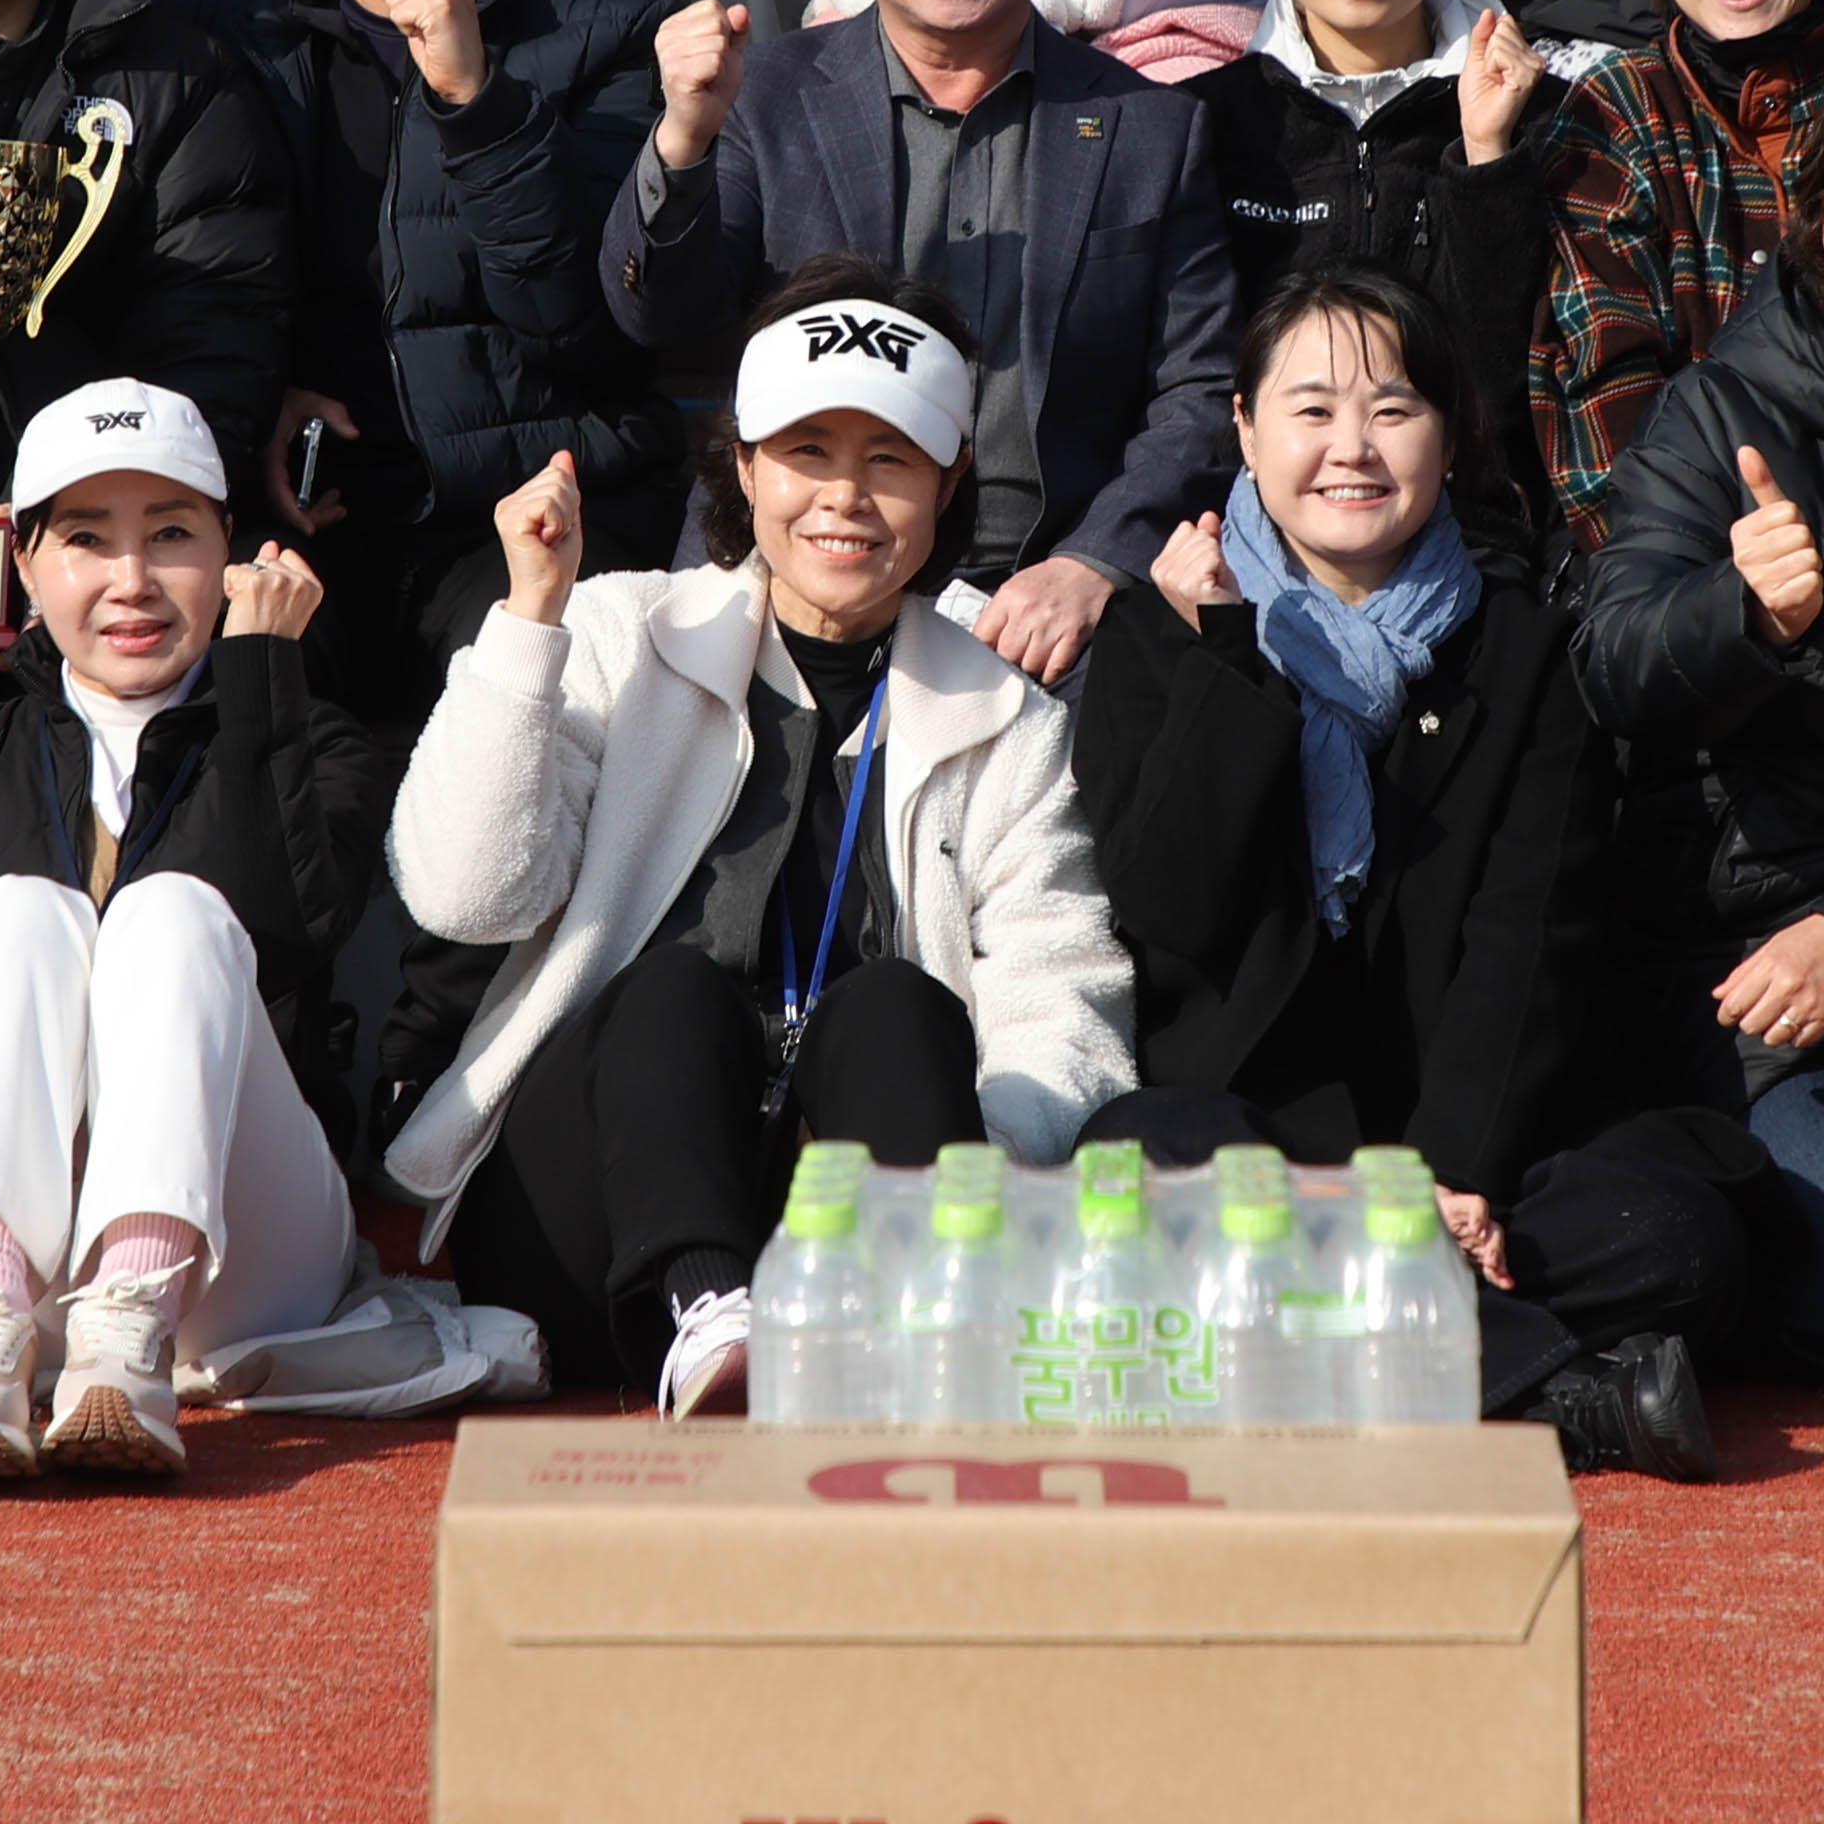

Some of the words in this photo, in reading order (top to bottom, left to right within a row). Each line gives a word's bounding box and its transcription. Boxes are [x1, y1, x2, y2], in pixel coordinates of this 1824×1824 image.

[796, 312, 927, 374] PXG
[84, 410, 147, 435] PXG
[1008, 1305, 1217, 1424] 풀무원
